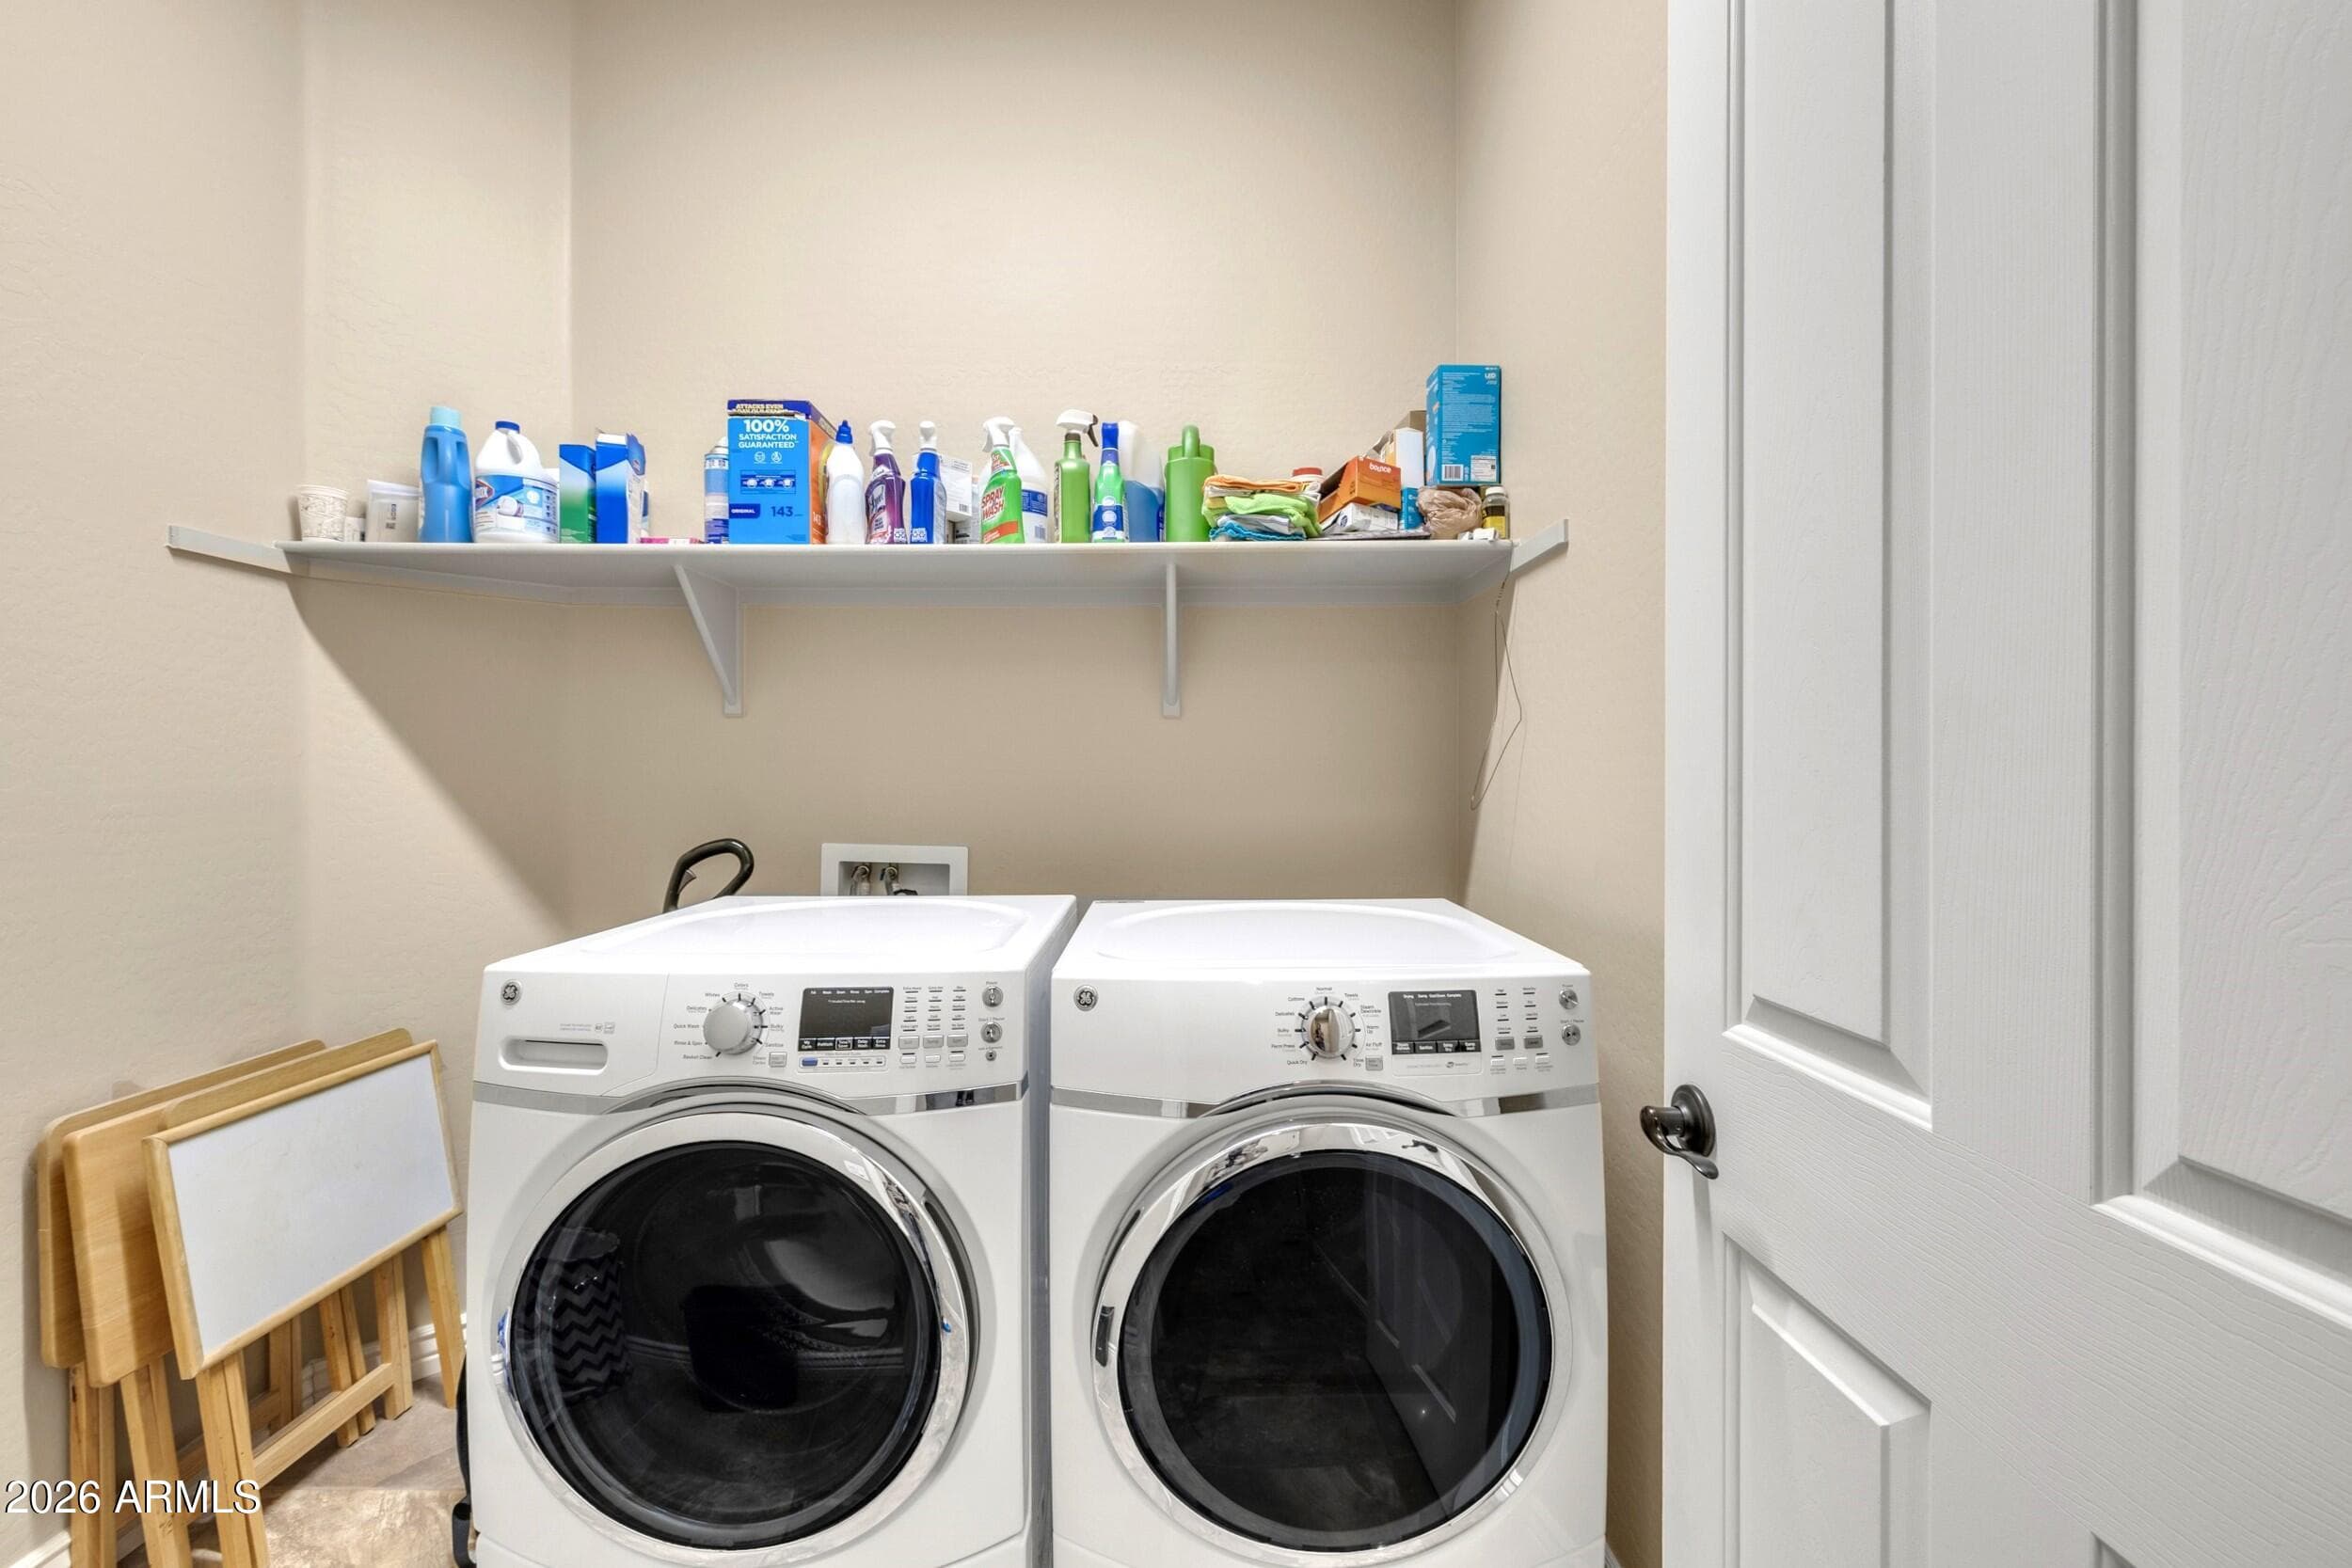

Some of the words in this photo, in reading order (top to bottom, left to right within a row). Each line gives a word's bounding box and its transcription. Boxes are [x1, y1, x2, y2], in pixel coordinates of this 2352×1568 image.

[743, 419, 790, 433] 100%
[1369, 462, 1391, 474] bounce
[981, 485, 1004, 508] SPRAY
[771, 506, 794, 517] 143
[983, 499, 1004, 521] WASH
